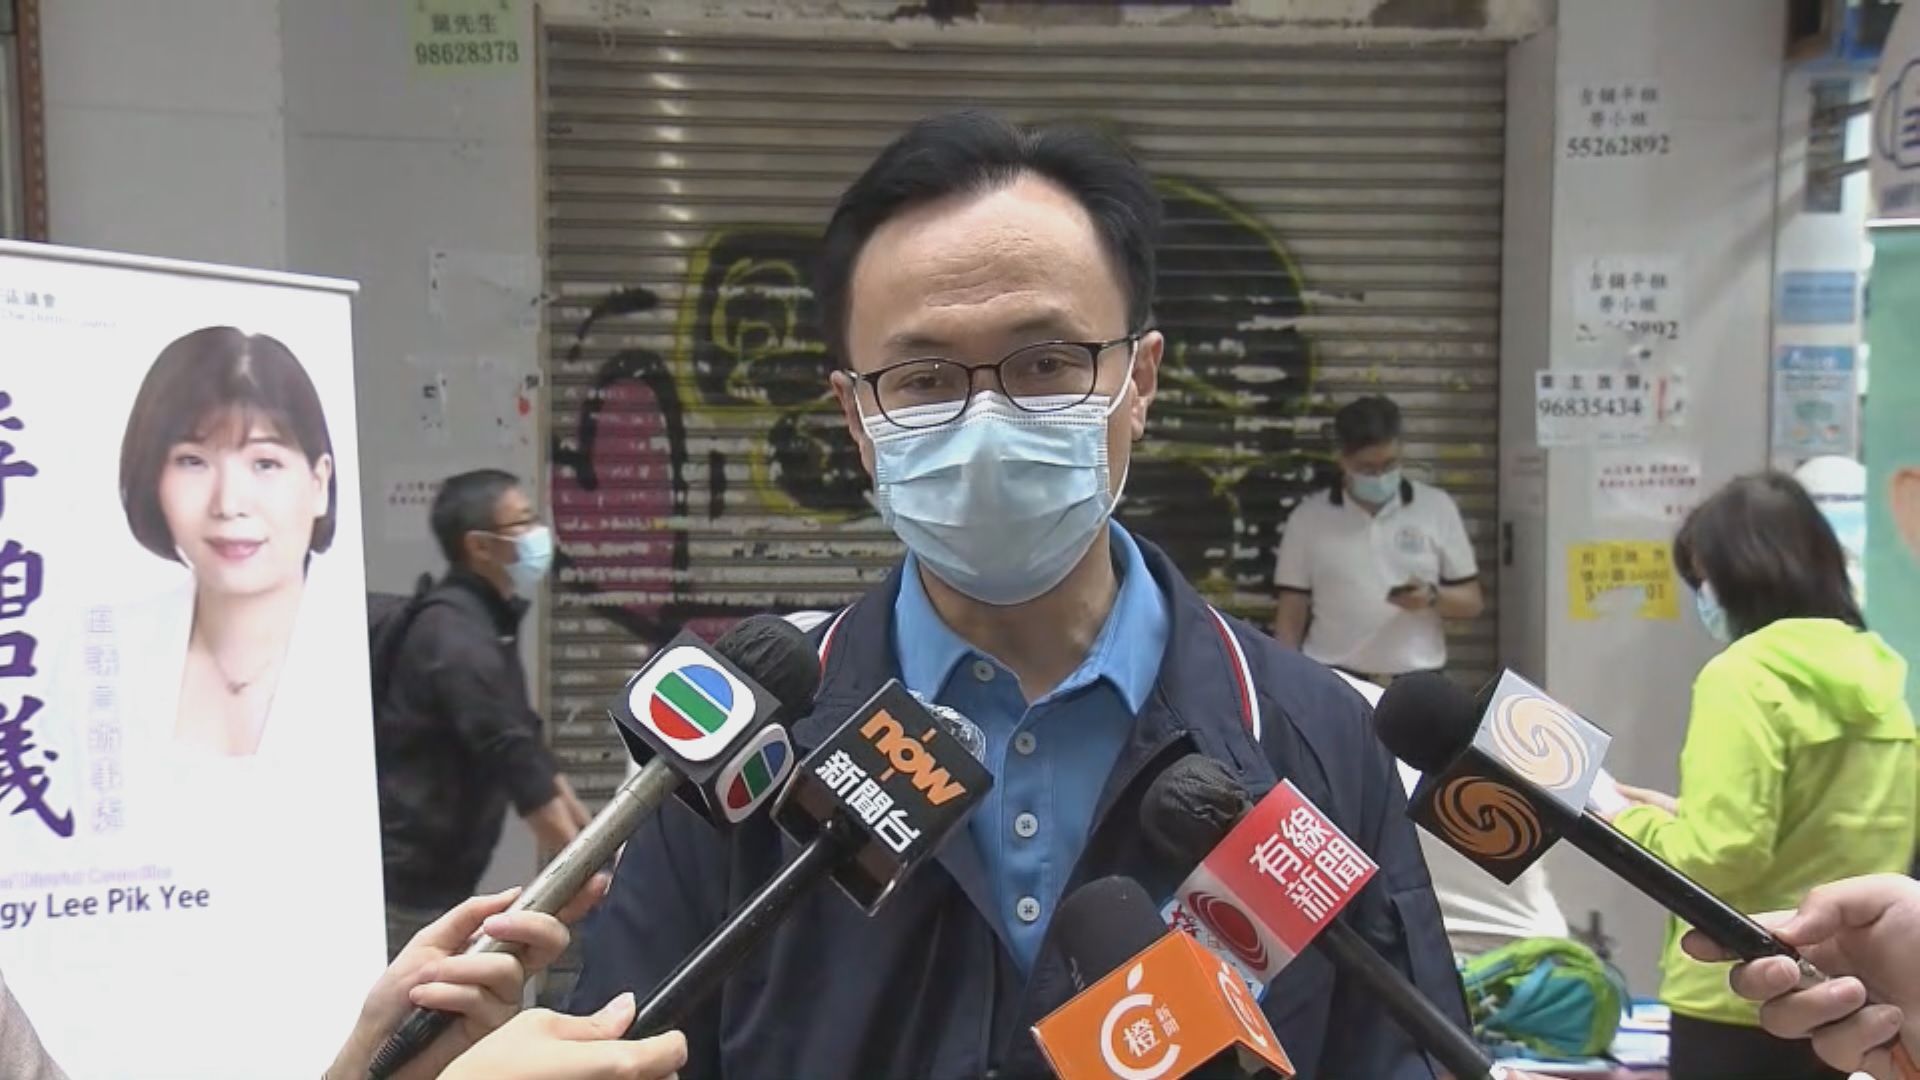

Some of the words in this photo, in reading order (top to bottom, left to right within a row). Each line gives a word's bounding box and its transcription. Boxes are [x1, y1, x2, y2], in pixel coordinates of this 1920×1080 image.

[416, 40, 519, 65] 98628373
[1566, 134, 1671, 158] 55262892
[1537, 396, 1642, 418] 96835434
[859, 708, 967, 806] now
[815, 749, 922, 854] 新聞台
[1248, 805, 1334, 885] 有線
[46, 892, 99, 918] Lee
[107, 886, 151, 914] Pik
[159, 884, 210, 910] Yee
[1284, 836, 1371, 924] 新聞
